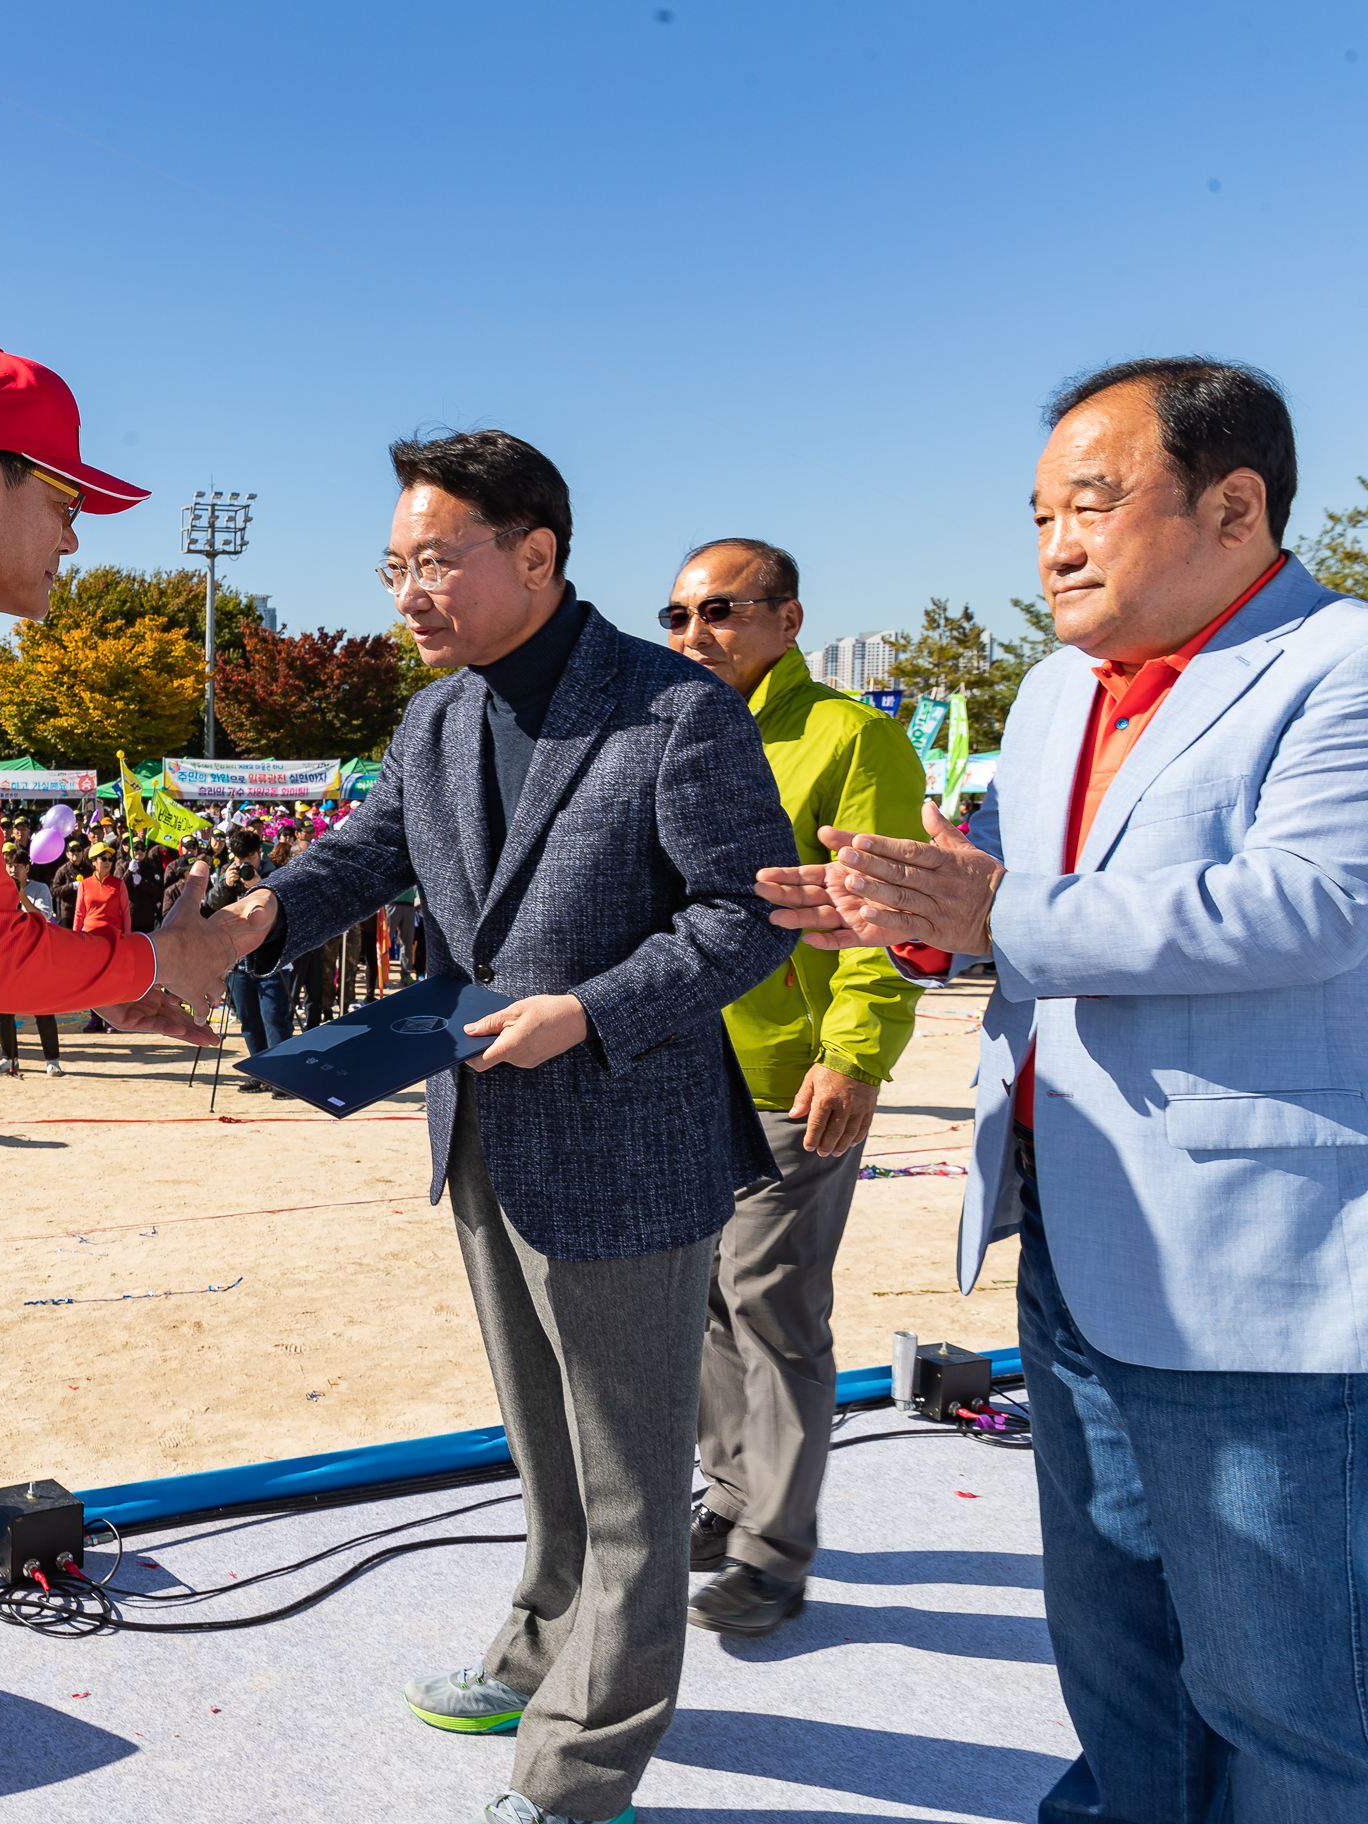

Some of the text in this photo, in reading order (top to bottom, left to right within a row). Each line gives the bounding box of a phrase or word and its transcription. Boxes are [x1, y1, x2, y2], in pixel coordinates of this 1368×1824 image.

[178, 771, 207, 783] 주민의
[248, 772, 287, 784] 일류광진
[198, 786, 225, 797] 승리의
[247, 787, 278, 797] 자양2동
